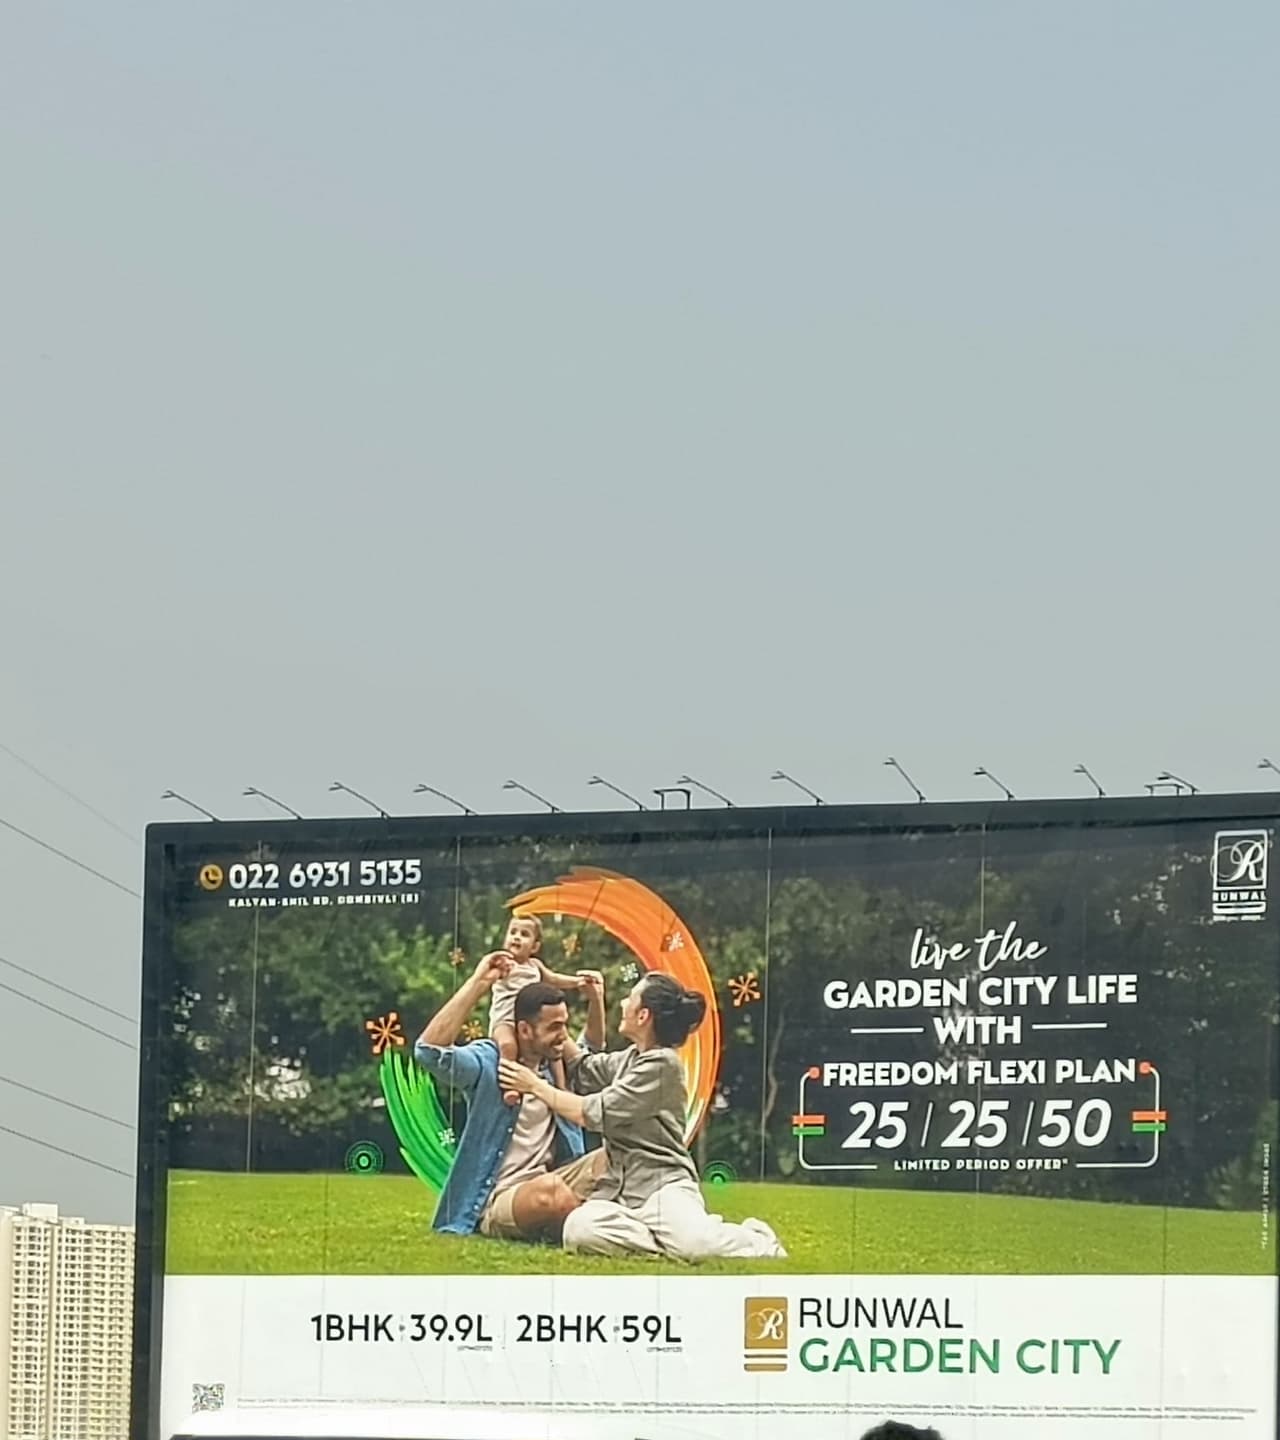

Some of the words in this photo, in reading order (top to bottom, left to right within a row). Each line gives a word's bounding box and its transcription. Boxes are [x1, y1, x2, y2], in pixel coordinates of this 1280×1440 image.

[228, 864, 280, 890] 022
[289, 861, 351, 887] 6931
[360, 859, 422, 886] 5135
[338, 894, 397, 905] DOMBIVLI
[1212, 890, 1267, 902] RUNWAL
[910, 928, 971, 970] live
[974, 920, 1048, 972] the
[823, 977, 968, 1009] GARDEN
[978, 975, 1058, 1006] CITY
[1067, 974, 1138, 1004] LIFE
[932, 1015, 1022, 1044] WITH
[822, 1061, 958, 1087] FREEDOM
[967, 1060, 1046, 1085] FLEXI
[1055, 1058, 1137, 1083] PLAN
[894, 1159, 950, 1171] LIMITED
[956, 1158, 1010, 1171] PERIOD
[311, 1313, 395, 1342] 1BHK
[410, 1313, 493, 1342] 39.9L
[516, 1314, 608, 1343] 2BHK
[622, 1314, 682, 1343] 59L
[799, 1297, 964, 1329] RUNWAL
[799, 1338, 1000, 1373] GARDEN
[1016, 1338, 1122, 1374] CITY
